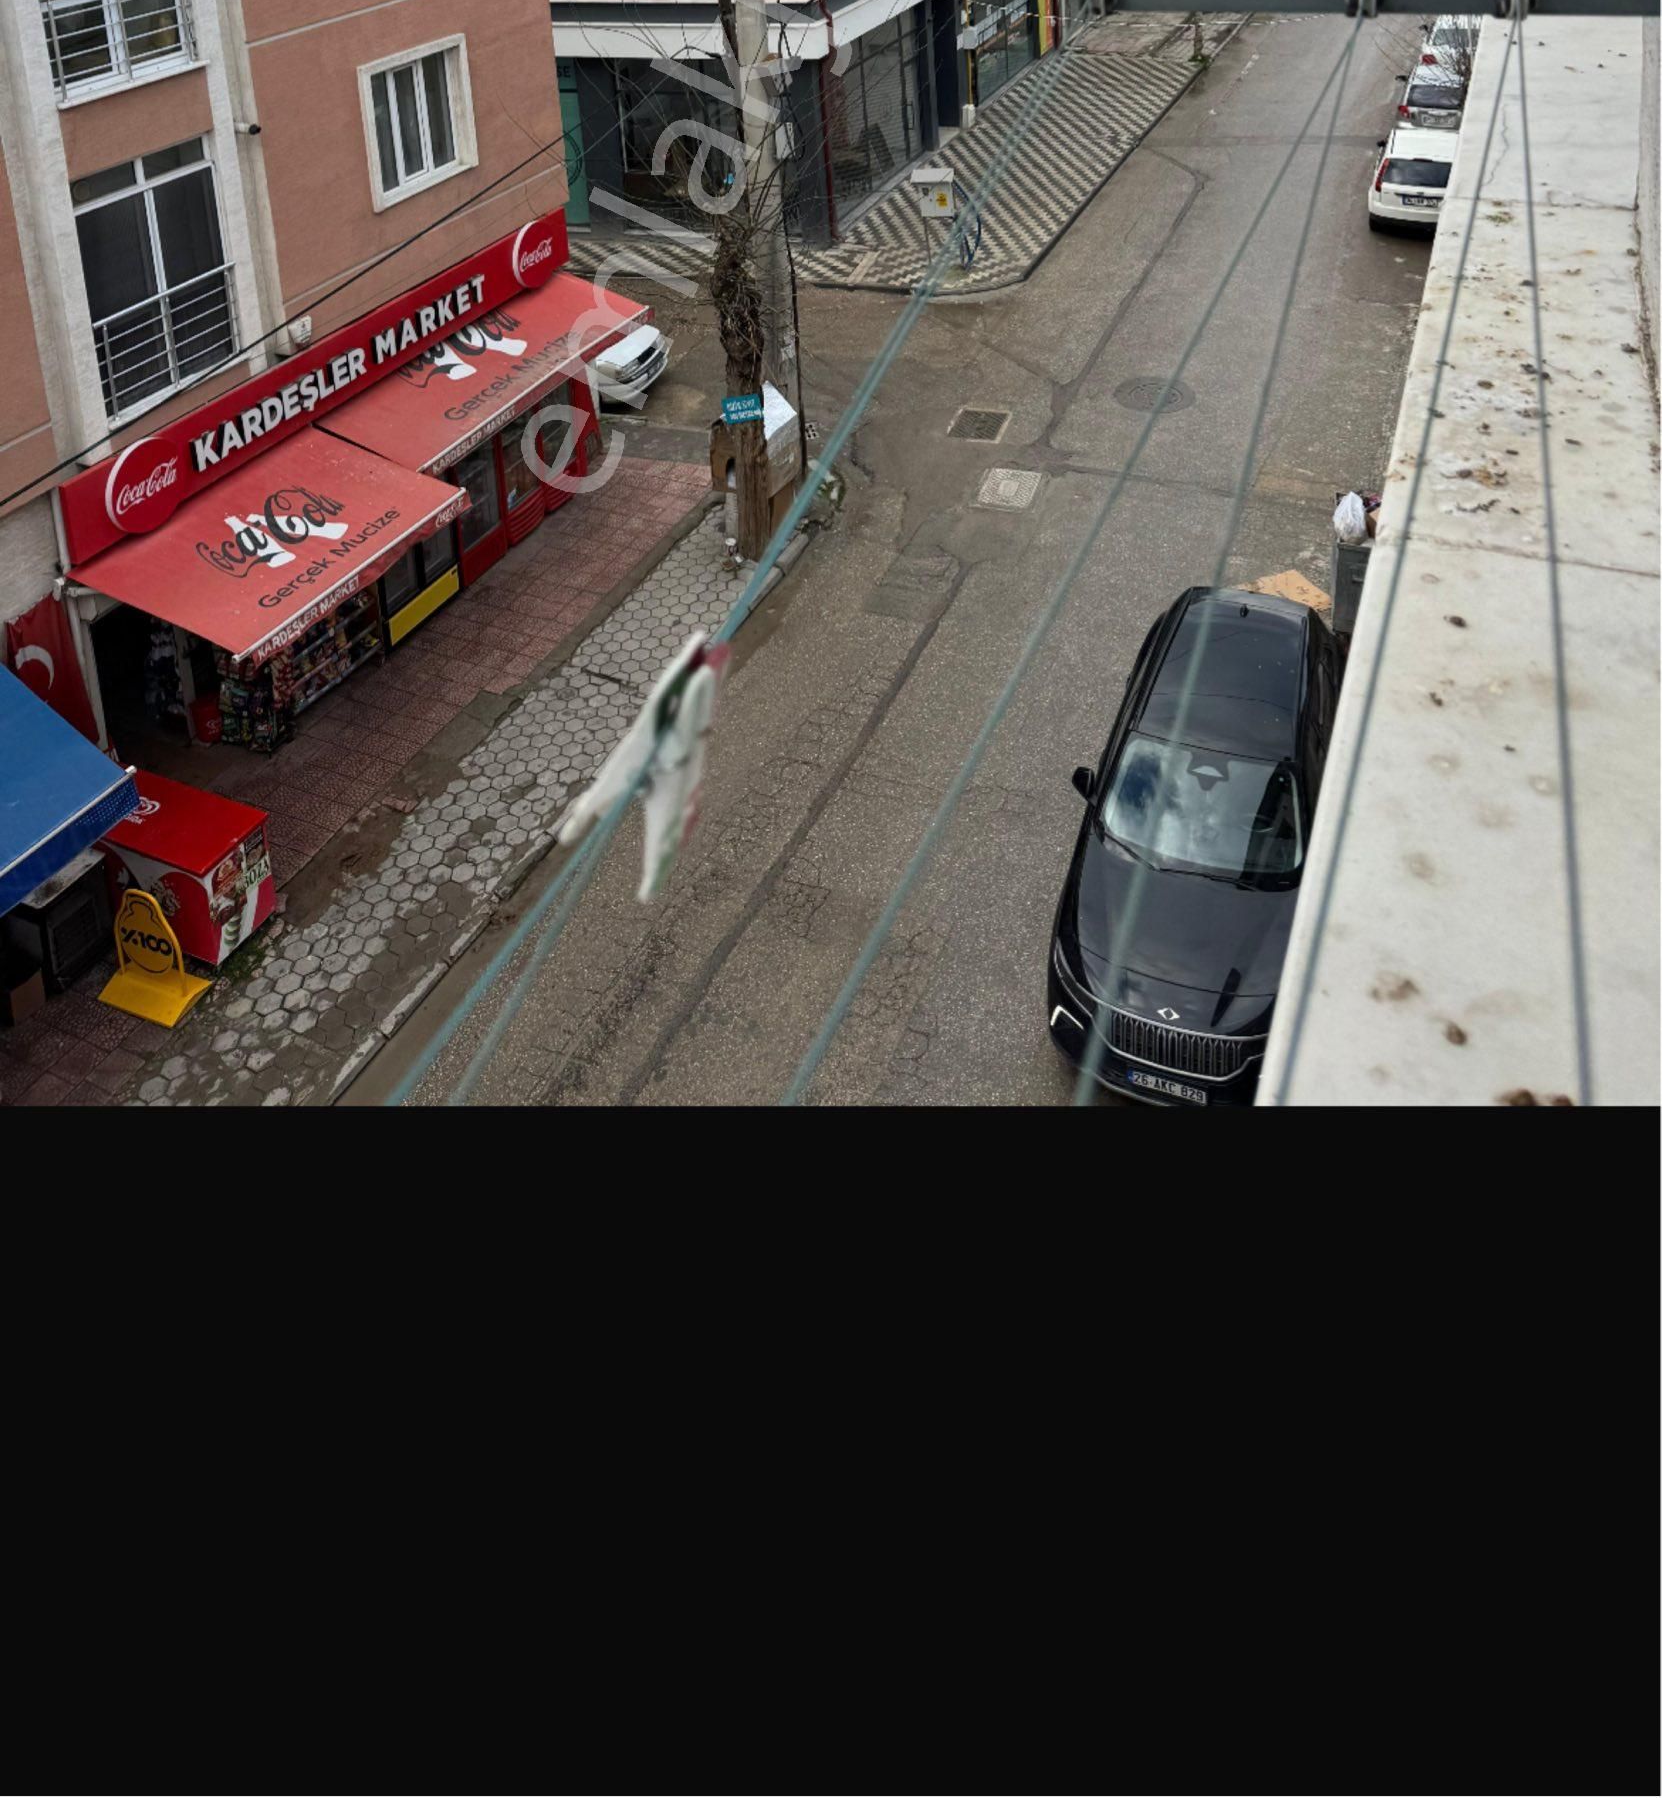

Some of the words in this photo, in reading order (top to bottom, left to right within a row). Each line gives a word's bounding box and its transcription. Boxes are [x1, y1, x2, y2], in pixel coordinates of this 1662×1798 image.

[192, 347, 367, 473] KARDEŞLER
[373, 274, 486, 365] MARKET
[258, 557, 335, 609] Gerçek
[329, 507, 401, 558] Mucize
[319, 575, 360, 615] MARKET
[1134, 1072, 1148, 1086] 26
